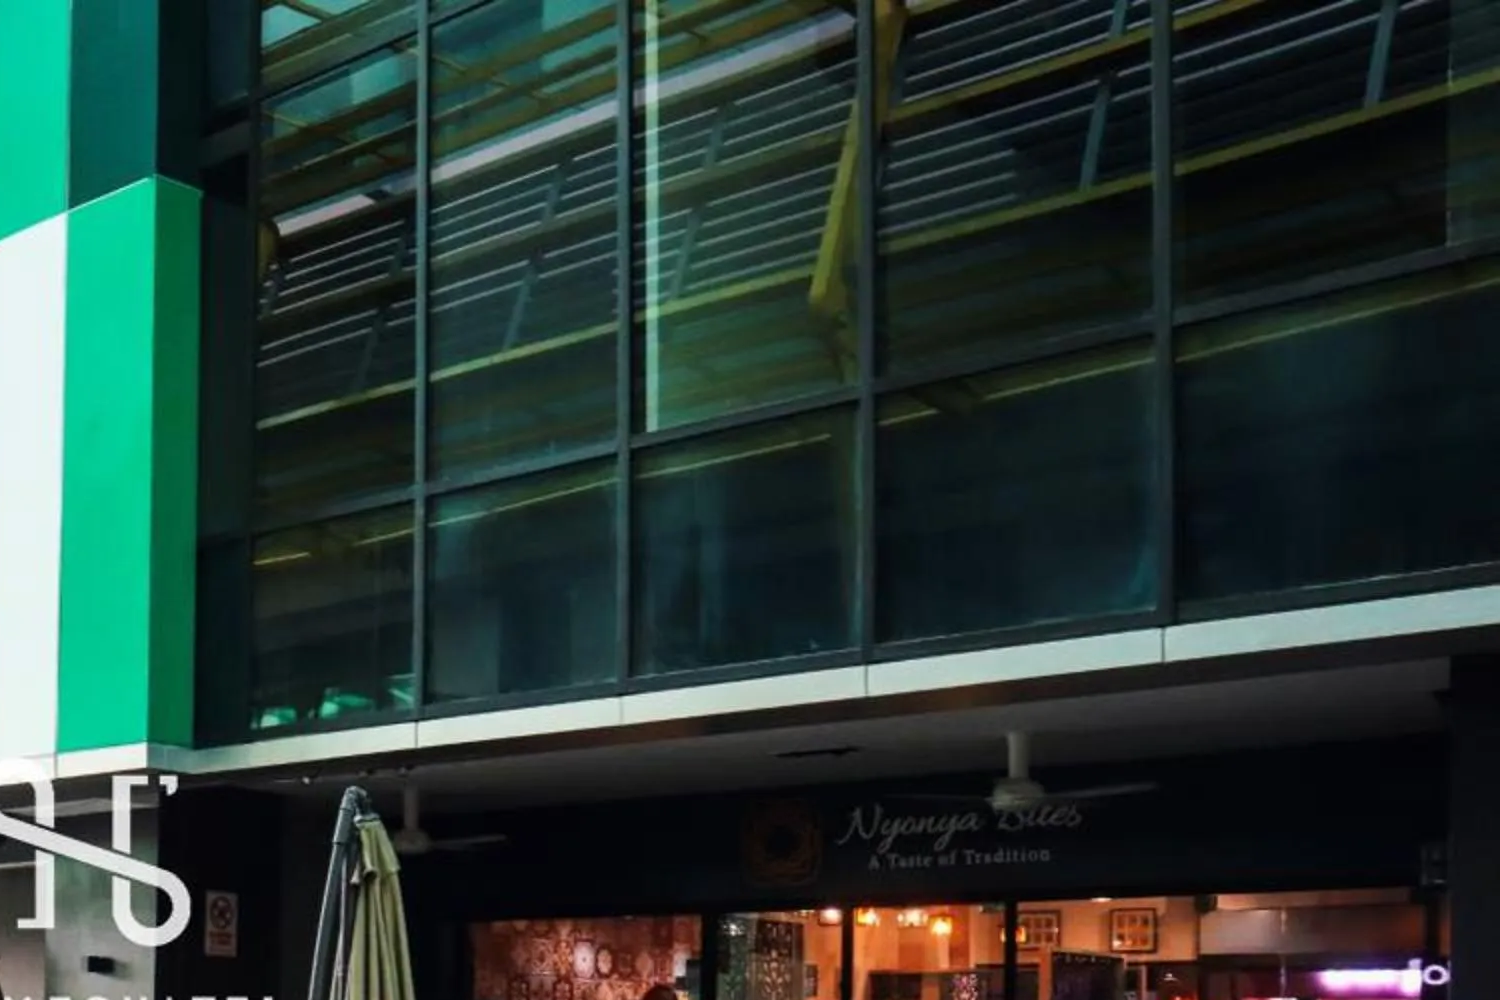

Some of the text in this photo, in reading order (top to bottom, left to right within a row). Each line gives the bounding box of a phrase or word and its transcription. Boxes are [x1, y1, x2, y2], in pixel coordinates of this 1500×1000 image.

[835, 803, 981, 854] Nyonya
[868, 847, 1051, 870] A Taste of Tradition
